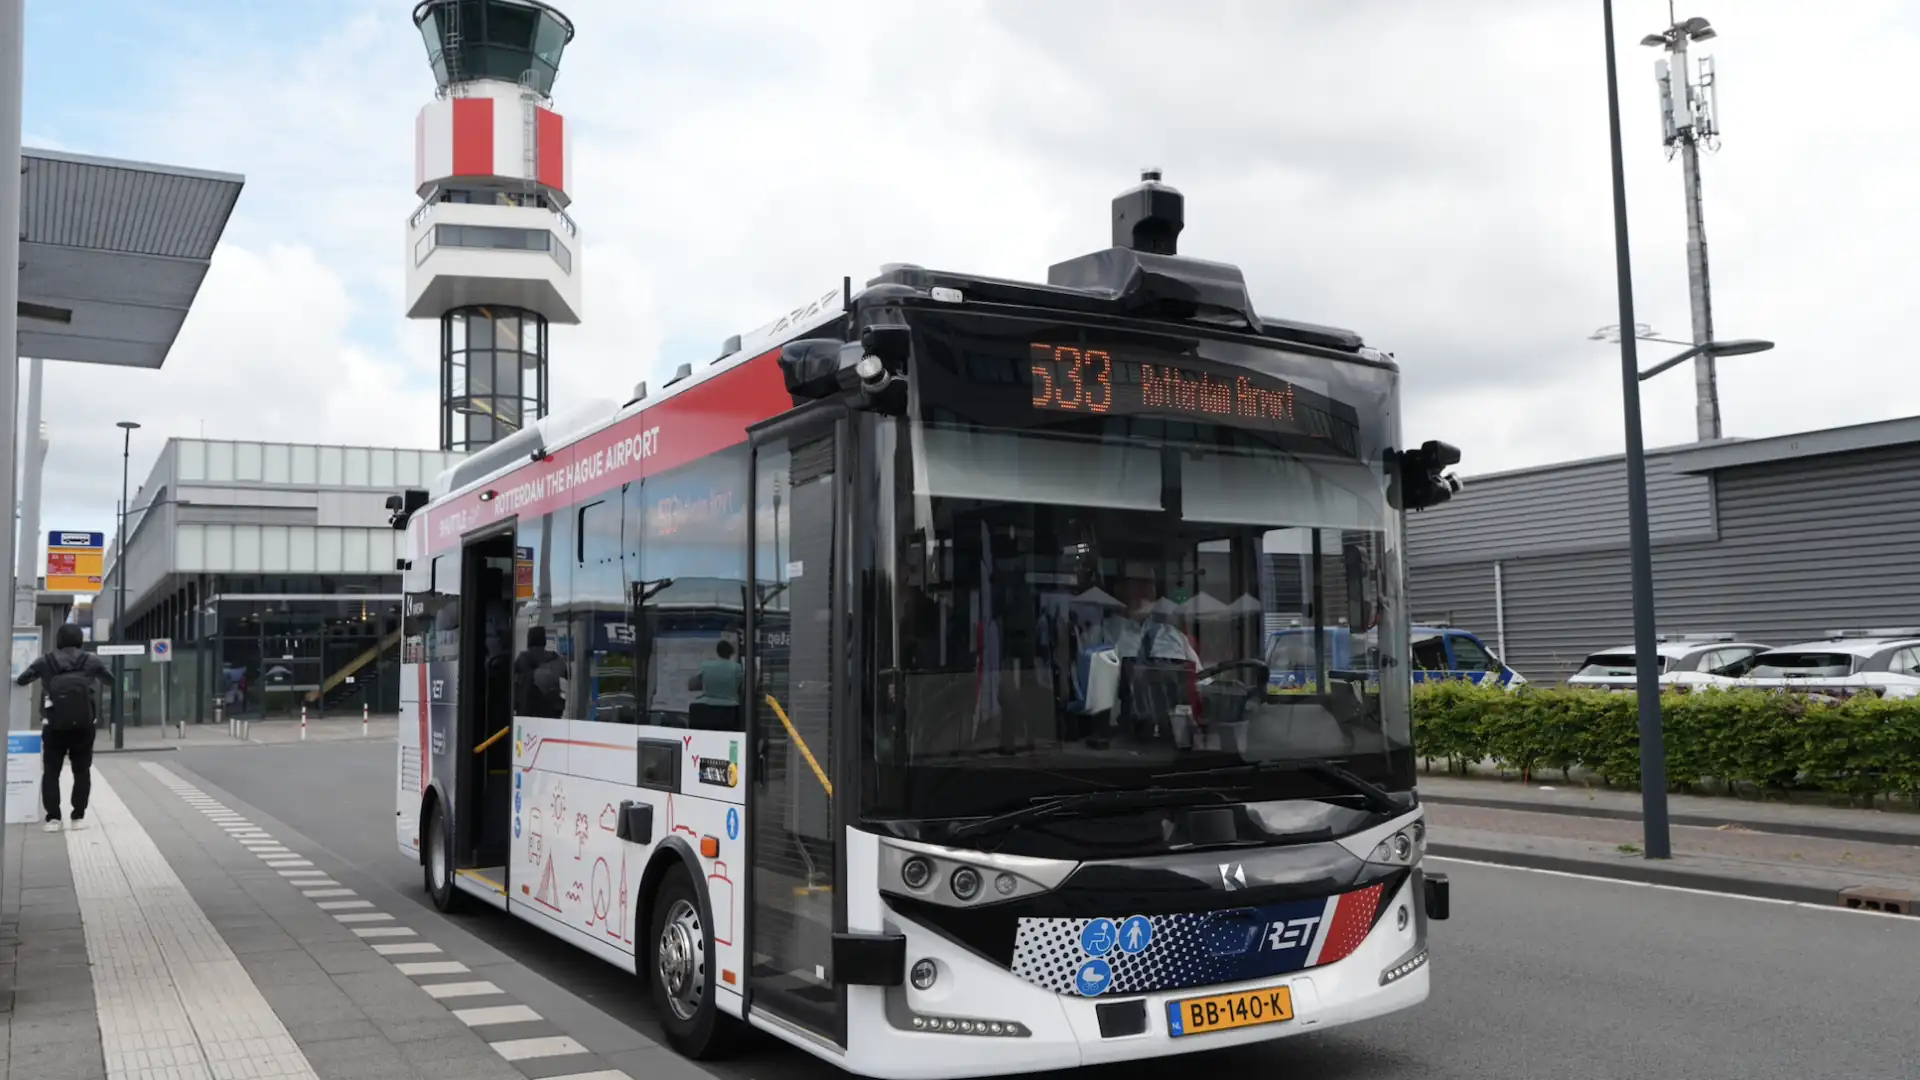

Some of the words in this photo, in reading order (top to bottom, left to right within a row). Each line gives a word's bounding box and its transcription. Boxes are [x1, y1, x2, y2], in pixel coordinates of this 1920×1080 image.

[1030, 342, 1111, 412] 533
[1142, 364, 1231, 414] Rotterdam
[1237, 375, 1295, 421] Airport
[494, 477, 545, 516] ROTTERDAM
[546, 469, 565, 497] THE
[566, 448, 603, 487] HAGUE
[605, 426, 660, 473] AIRPORT
[1268, 916, 1321, 951] RET
[1172, 1022, 1182, 1030] NL
[1190, 992, 1284, 1028] BB-140-K
